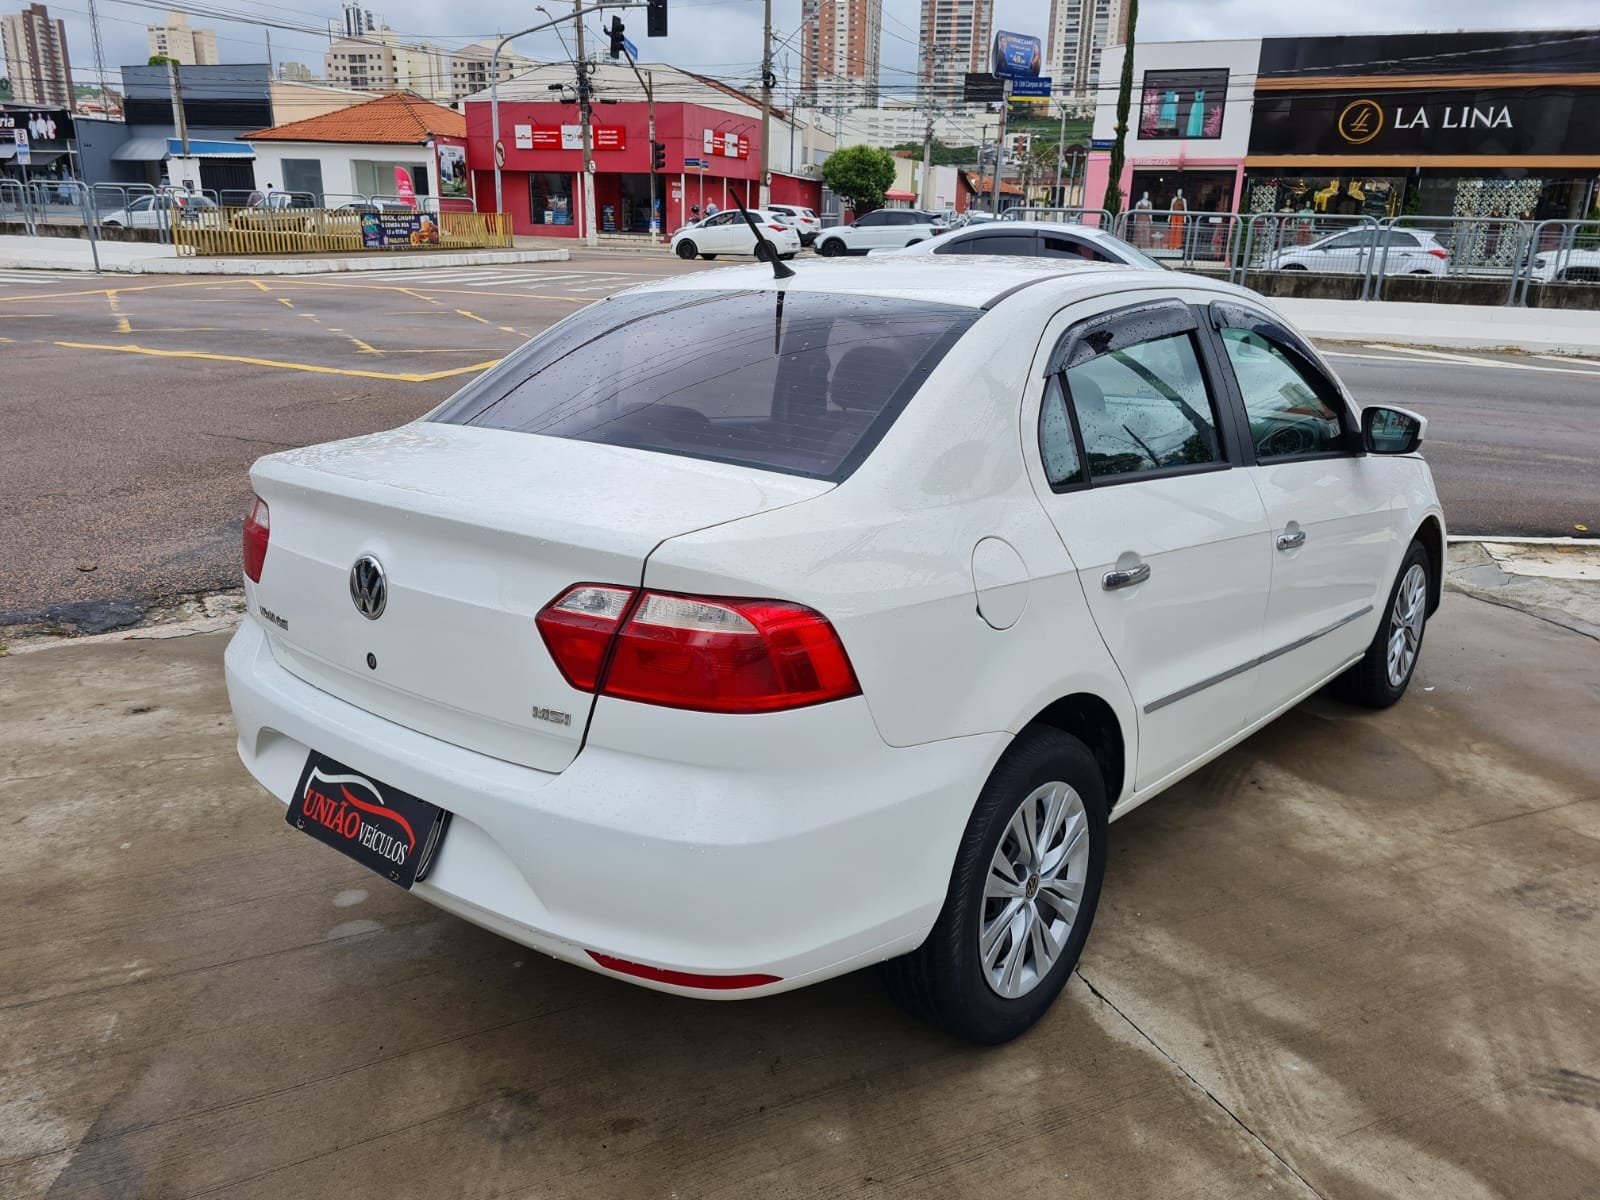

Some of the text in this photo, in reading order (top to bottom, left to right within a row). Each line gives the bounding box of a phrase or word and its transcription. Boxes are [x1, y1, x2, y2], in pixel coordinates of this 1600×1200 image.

[1394, 105, 1514, 129] LA LINA
[532, 706, 571, 727] MSI
[303, 788, 408, 865] UNIÃO VEÍCULOS
